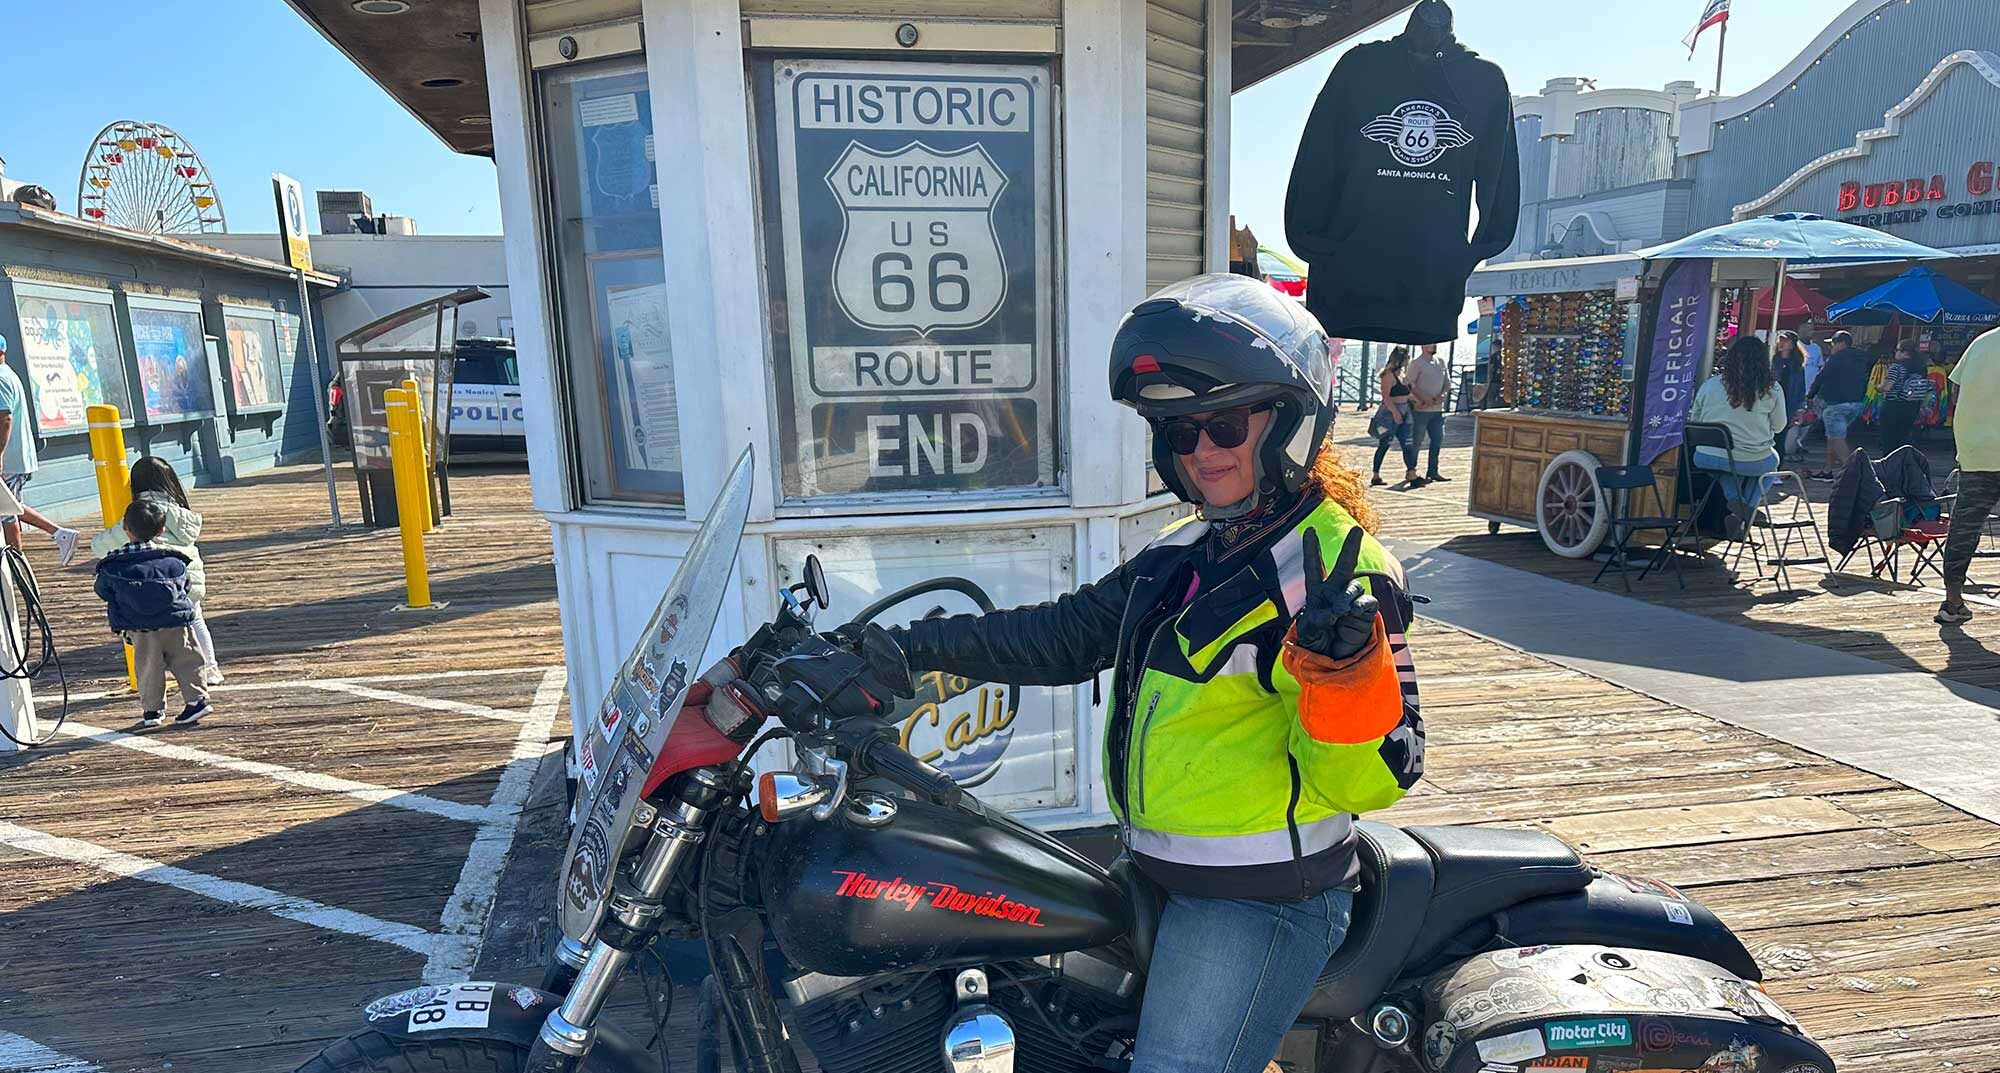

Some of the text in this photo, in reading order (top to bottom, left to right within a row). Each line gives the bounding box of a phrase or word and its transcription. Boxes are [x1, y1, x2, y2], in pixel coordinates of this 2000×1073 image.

[813, 84, 1016, 127] HISTORIC
[1400, 104, 1440, 117] AMERICA'S
[1407, 118, 1430, 126] ROUTE
[1405, 129, 1429, 148] 66
[1395, 148, 1438, 163] MAIN STREET
[847, 164, 988, 197] CALIFORNIA
[1377, 168, 1401, 178] SANTA
[1402, 170, 1436, 179] MONICA
[1839, 161, 2000, 210] BUBBA G
[1837, 207, 1928, 227] HRIMP
[872, 252, 970, 313] 66
[1944, 312, 1997, 322] BUBBA GUMP
[1661, 297, 1684, 402] OFFICIAL
[854, 350, 993, 387] ROUTE
[450, 406, 524, 421] POLIC
[867, 412, 988, 477] END
[899, 687, 1014, 763] Cali
[832, 870, 1046, 927] Harley-Davidson
[1550, 1022, 1626, 1040] Motor City
[1532, 1057, 1584, 1068] NDIAN
